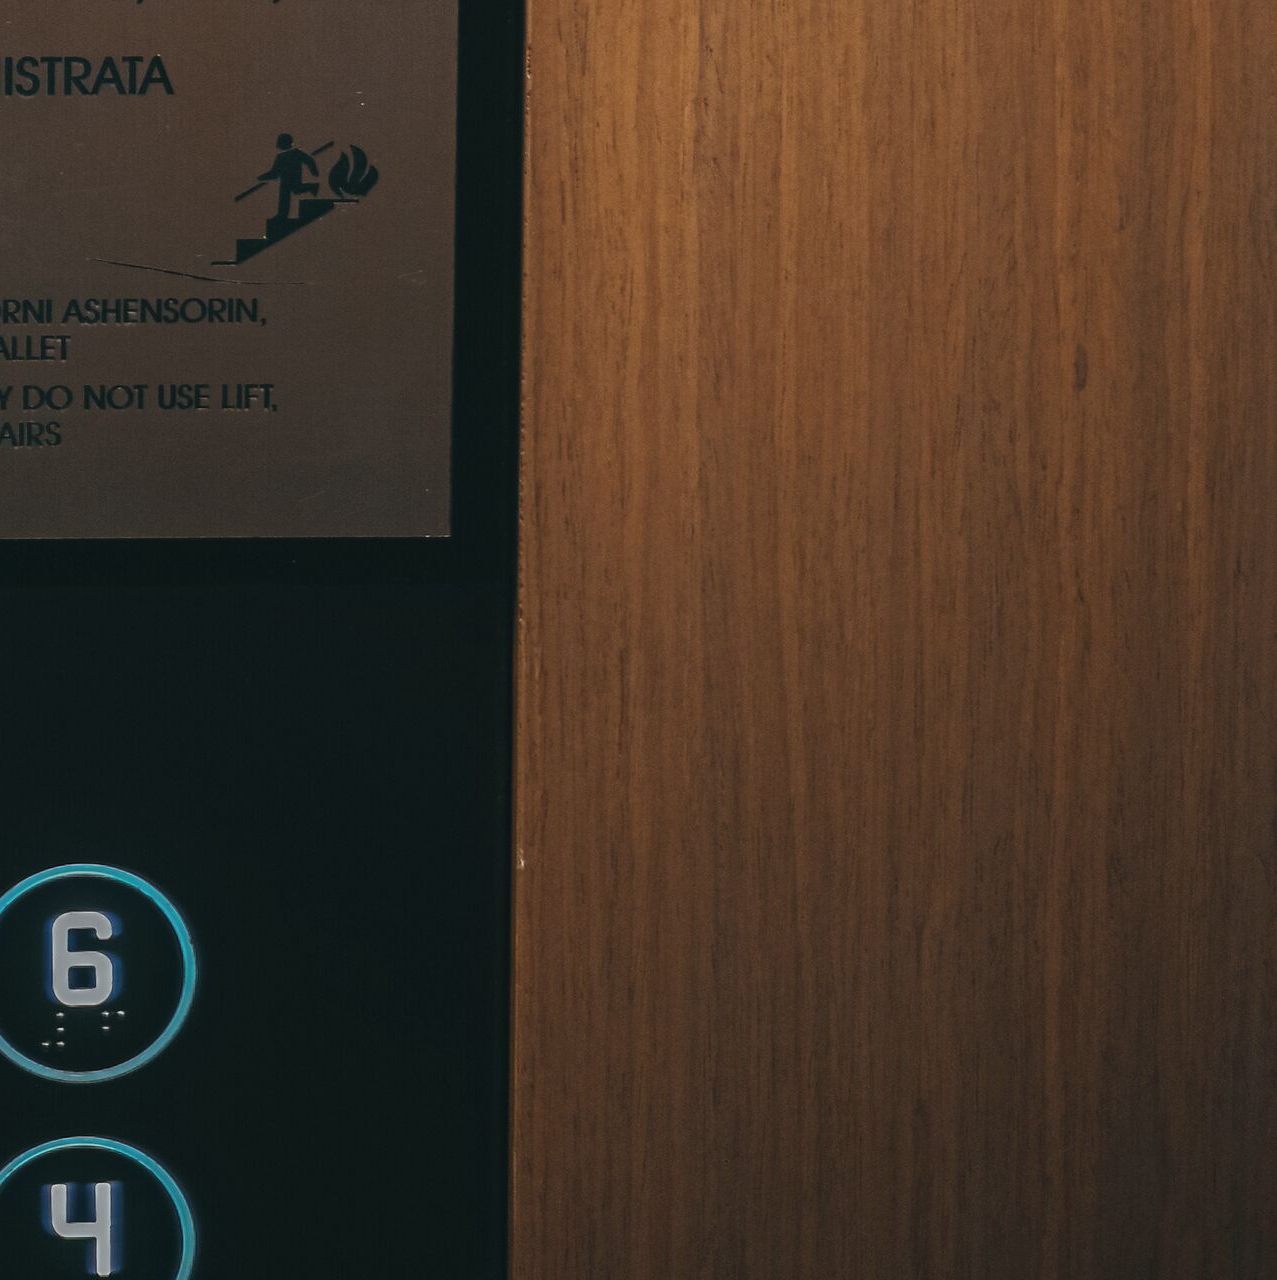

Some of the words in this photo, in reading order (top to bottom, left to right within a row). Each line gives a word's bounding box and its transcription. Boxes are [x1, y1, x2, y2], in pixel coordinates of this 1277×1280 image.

[61, 297, 267, 327] ASHENSORIN,
[22, 384, 74, 411] DO
[83, 383, 149, 410] NOT
[157, 383, 210, 411] USE
[220, 382, 278, 413] LIFT,
[51, 910, 113, 1006] 6
[48, 1182, 113, 1278] 4
